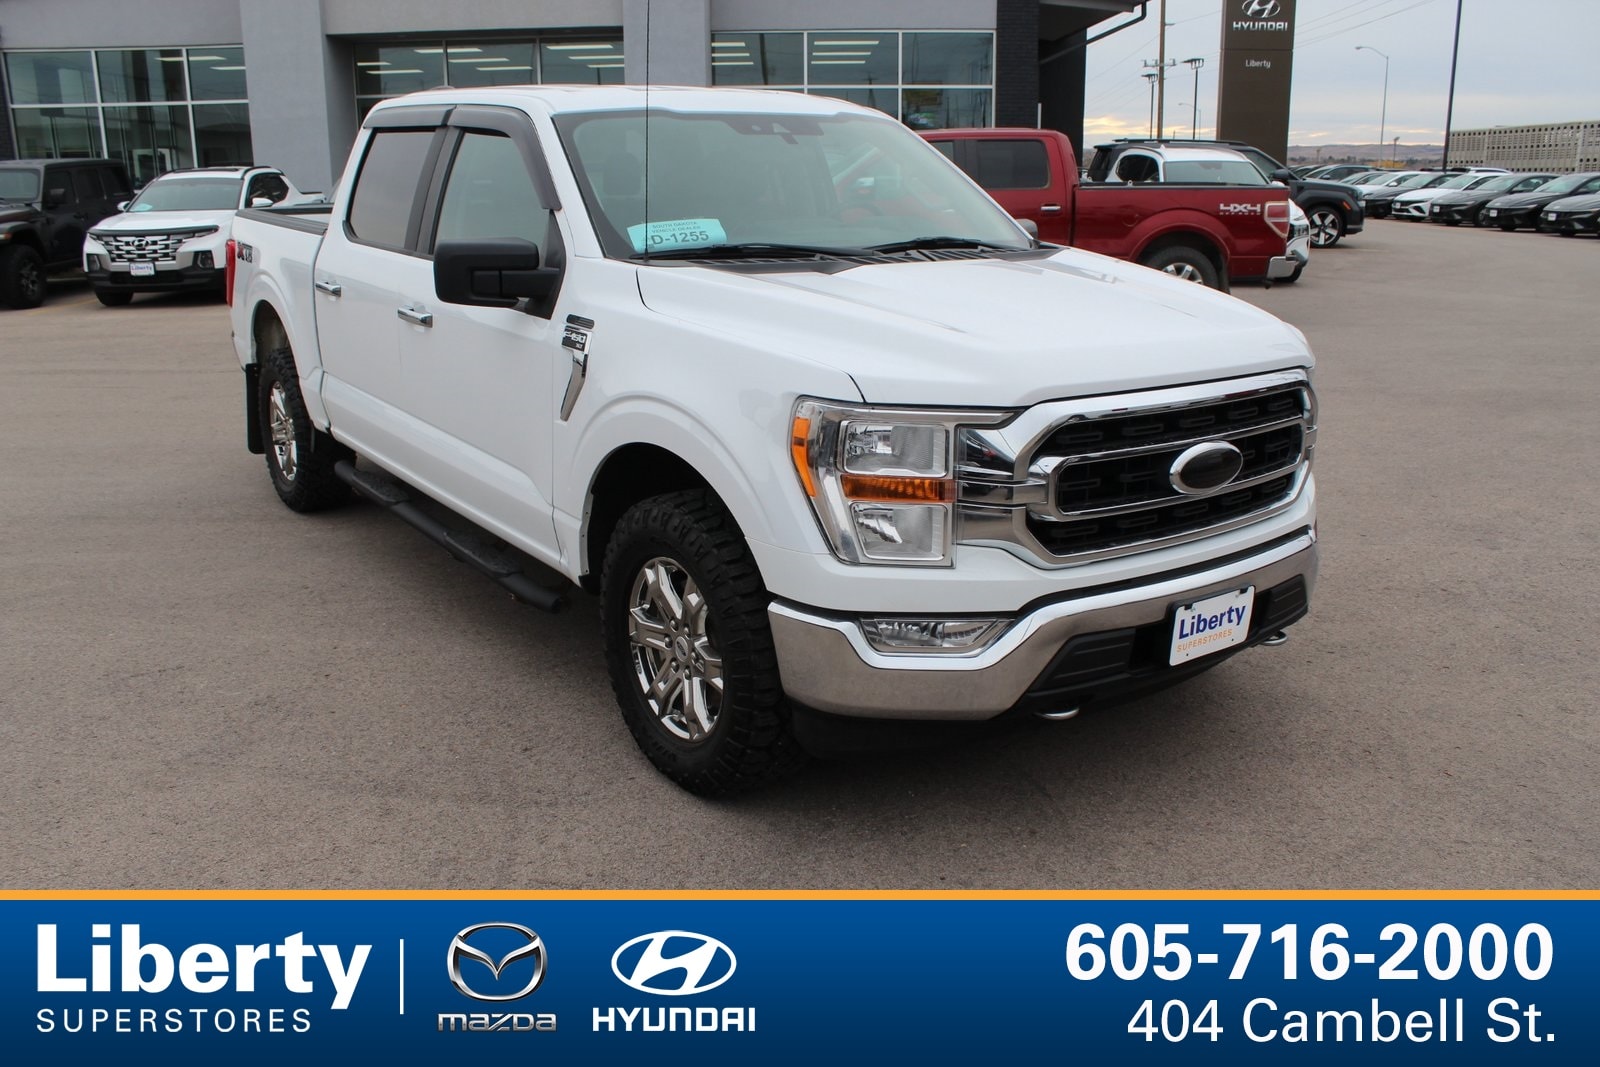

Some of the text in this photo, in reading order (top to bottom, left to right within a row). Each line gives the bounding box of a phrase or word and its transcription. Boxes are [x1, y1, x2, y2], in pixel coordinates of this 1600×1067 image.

[1232, 21, 1288, 31] HYUNDAI
[1245, 59, 1271, 69] Liberty
[650, 230, 709, 245] D-1255
[1178, 605, 1246, 640] Liberty
[1176, 628, 1233, 653] SUPERSTORES
